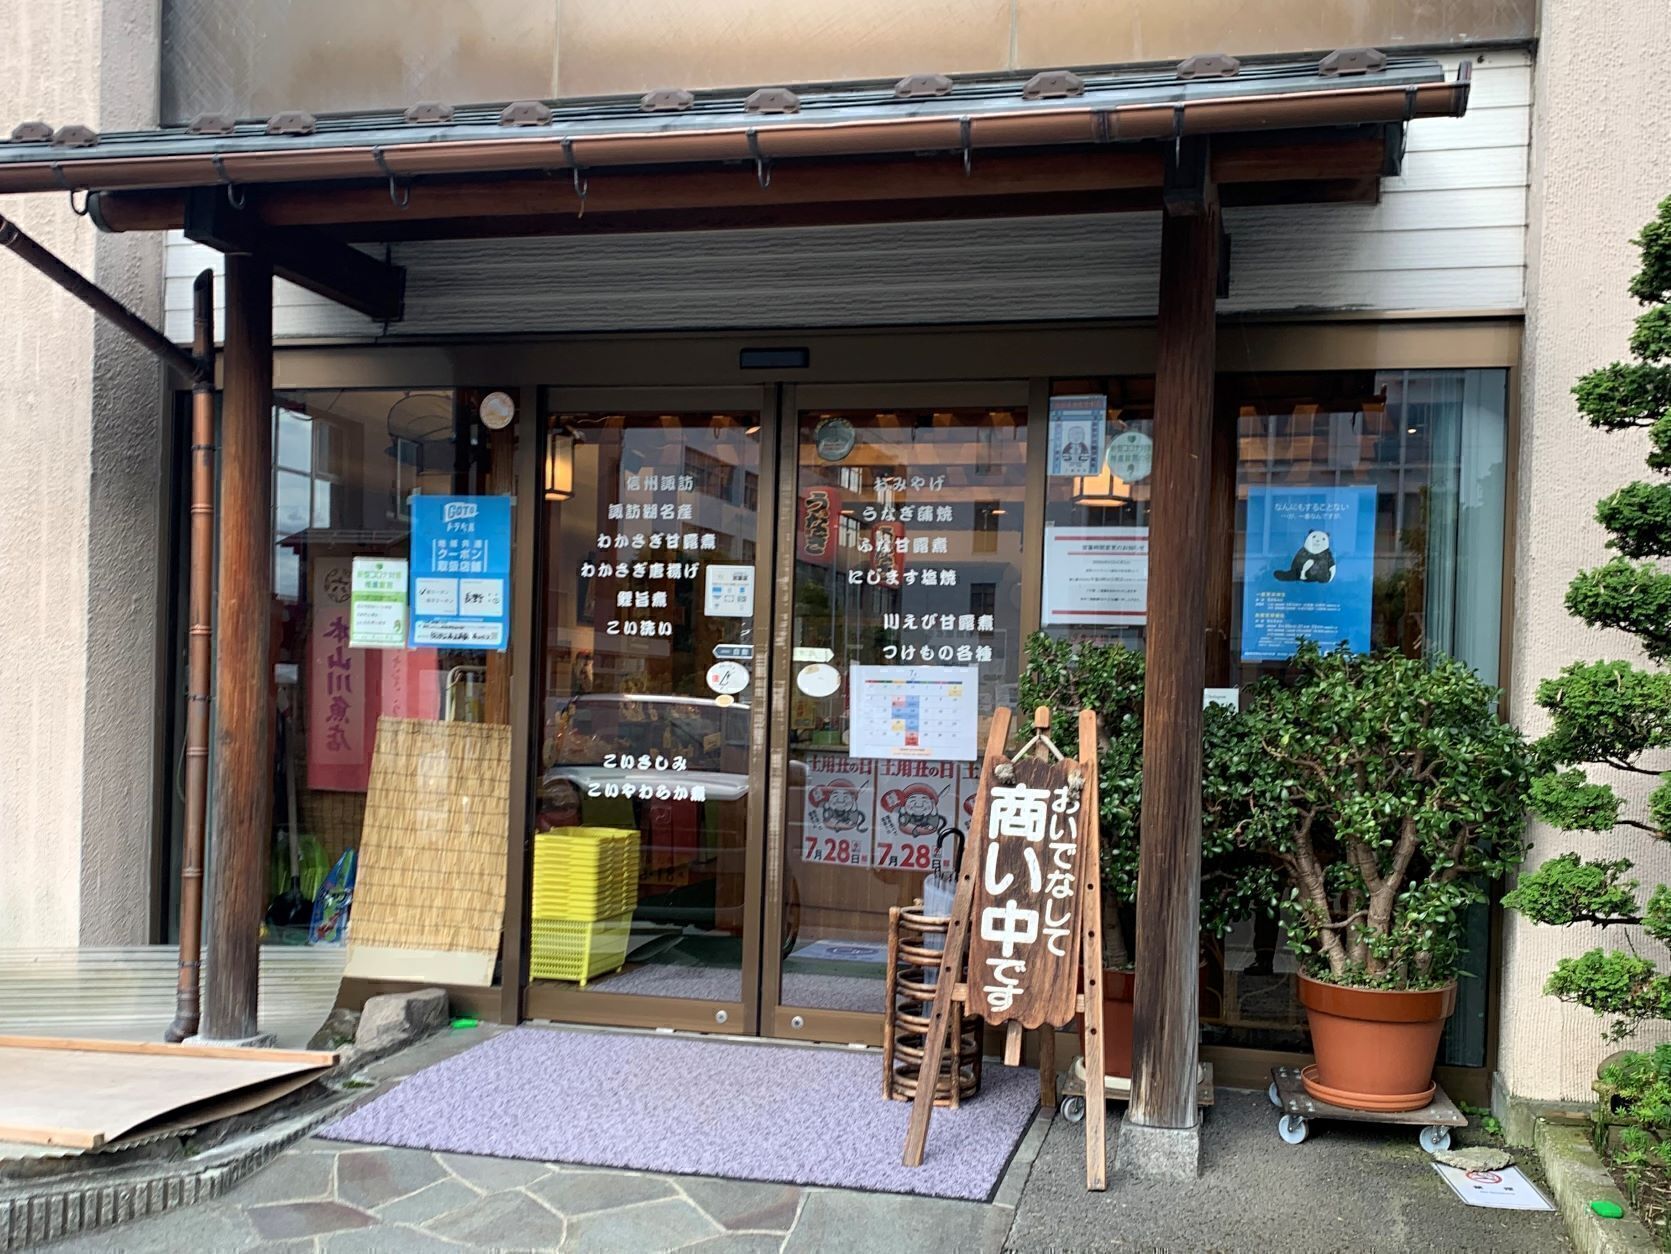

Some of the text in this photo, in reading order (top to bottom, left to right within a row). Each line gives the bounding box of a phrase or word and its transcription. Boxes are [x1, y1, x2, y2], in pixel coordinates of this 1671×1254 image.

[627, 475, 694, 491] 信州諏訪
[873, 475, 946, 492] おみやげ
[607, 503, 693, 520] 諏訪湖名産
[862, 504, 953, 522] うなぎ蒲焼
[596, 532, 717, 550] わかさぎ甘露煮
[858, 536, 948, 554] ふな甘露煮
[438, 548, 483, 560] クーポン
[580, 561, 700, 580] わかさぎ唐揚げ
[848, 568, 957, 586] にじます塩焼
[606, 620, 673, 637] こい洗い
[883, 612, 994, 632] 川えび甘露煮
[882, 644, 993, 662] つけもの各種
[602, 753, 688, 772] こいさしみ
[880, 759, 955, 778] 土用丑の日
[587, 782, 707, 803] こいやわらか煮
[1042, 785, 1081, 957] おいでなして
[981, 783, 1051, 1013] 商い中です
